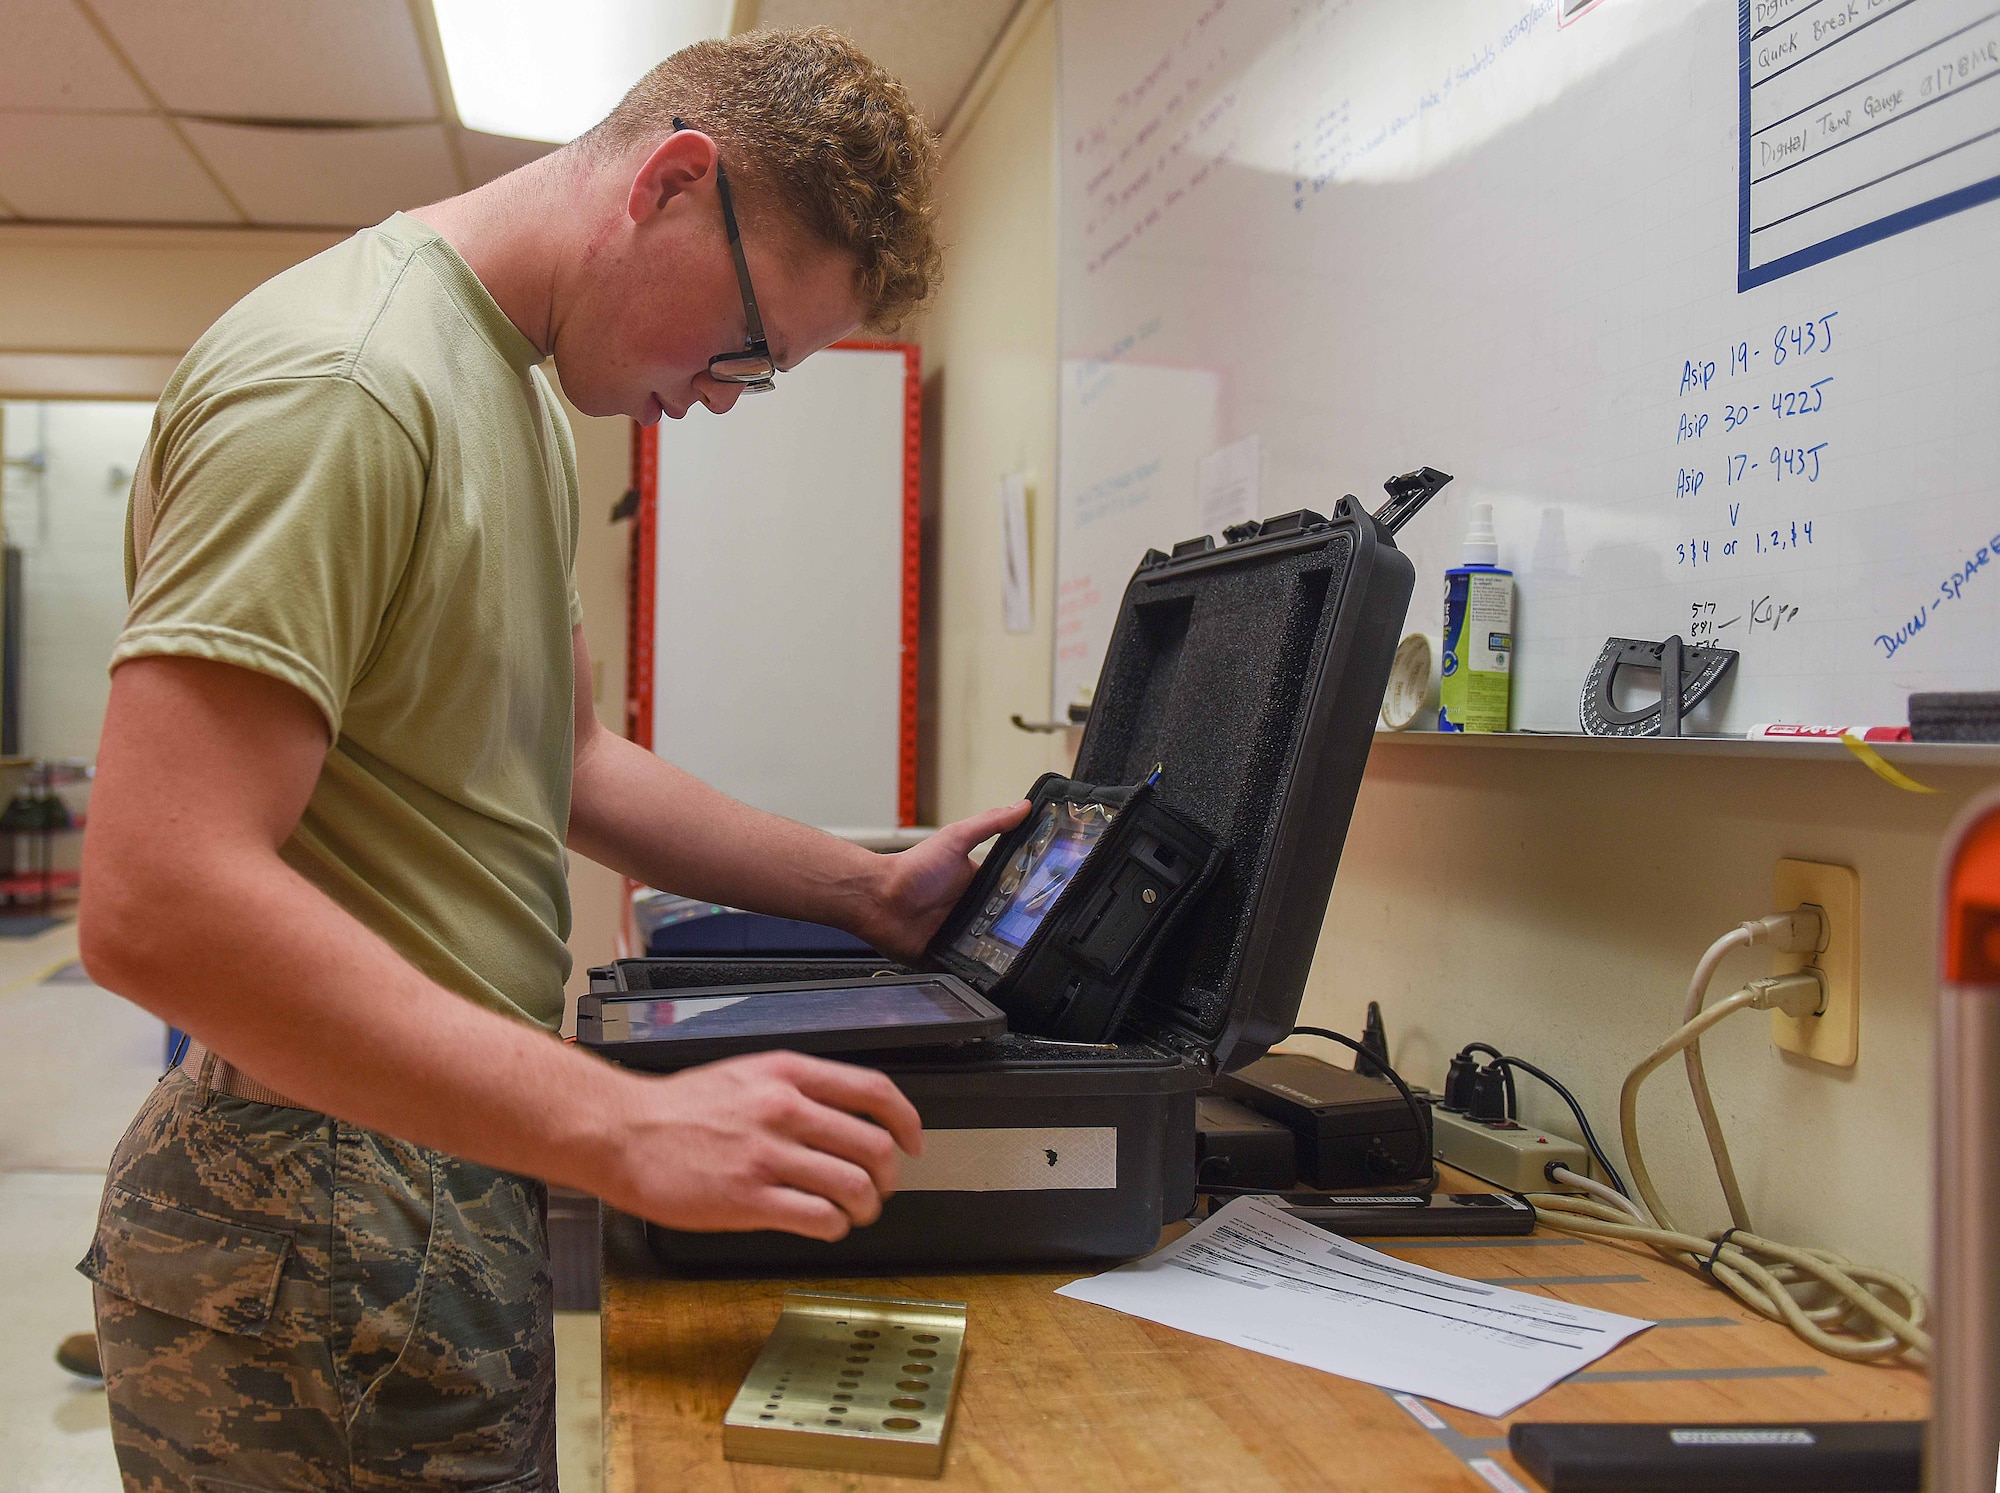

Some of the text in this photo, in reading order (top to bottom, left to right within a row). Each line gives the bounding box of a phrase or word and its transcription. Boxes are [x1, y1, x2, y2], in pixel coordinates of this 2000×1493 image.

[1679, 360, 1716, 397] Asip
[1677, 413, 1709, 445] Asip
[1676, 468, 1704, 499] Asip
[1723, 540, 1738, 555] or
